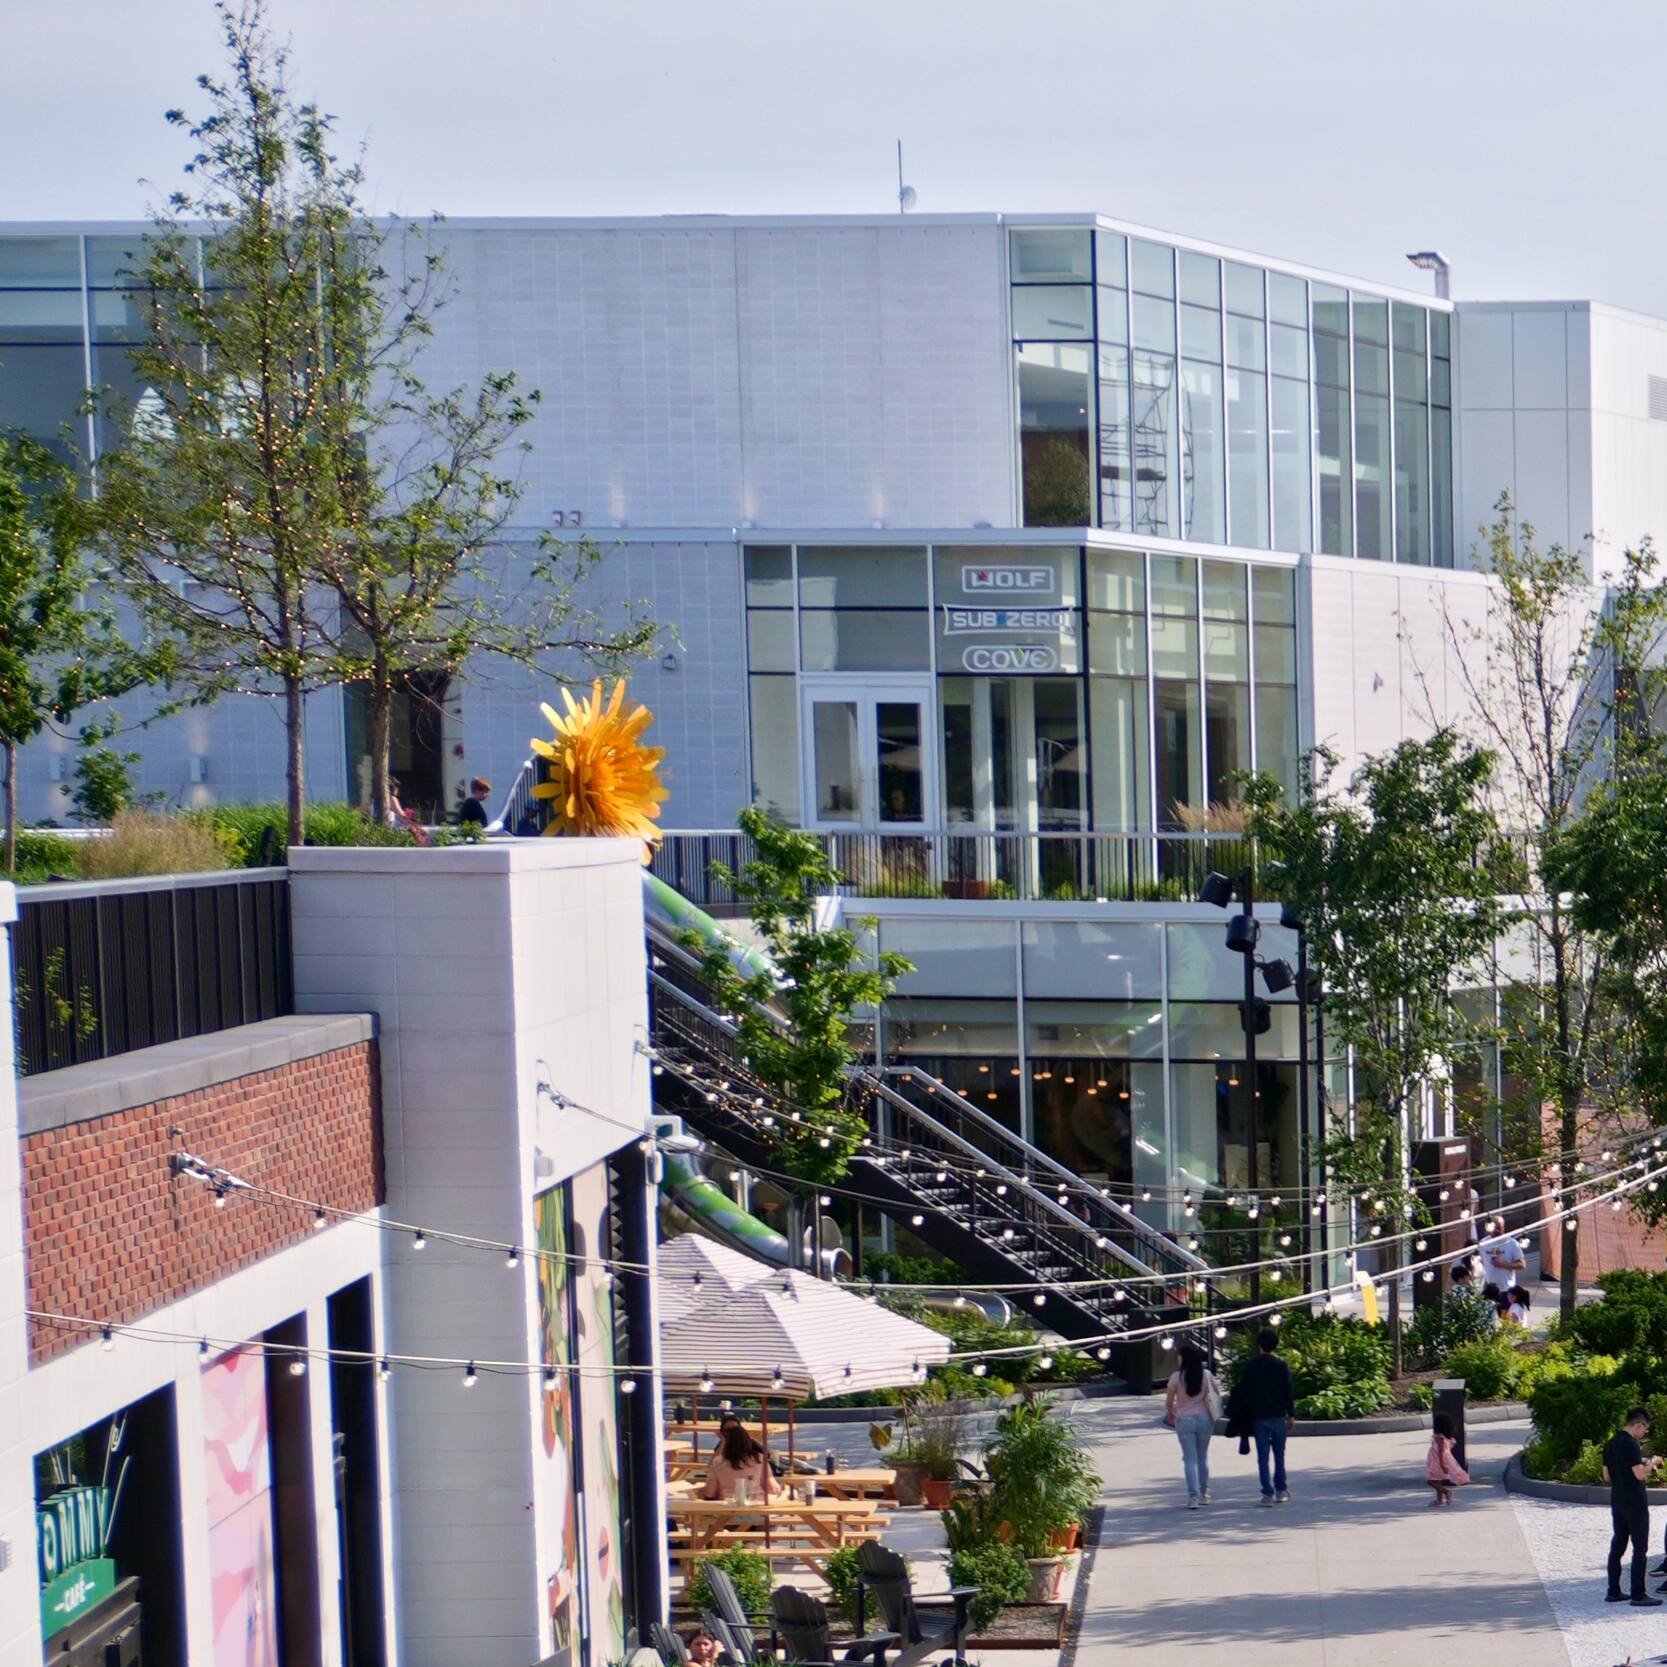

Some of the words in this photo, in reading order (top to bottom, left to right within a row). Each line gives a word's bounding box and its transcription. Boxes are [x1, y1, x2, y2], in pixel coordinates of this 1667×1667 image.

[971, 570, 1046, 588] WOLF
[973, 649, 1049, 669] COVE
[37, 1486, 109, 1578] OMMY
